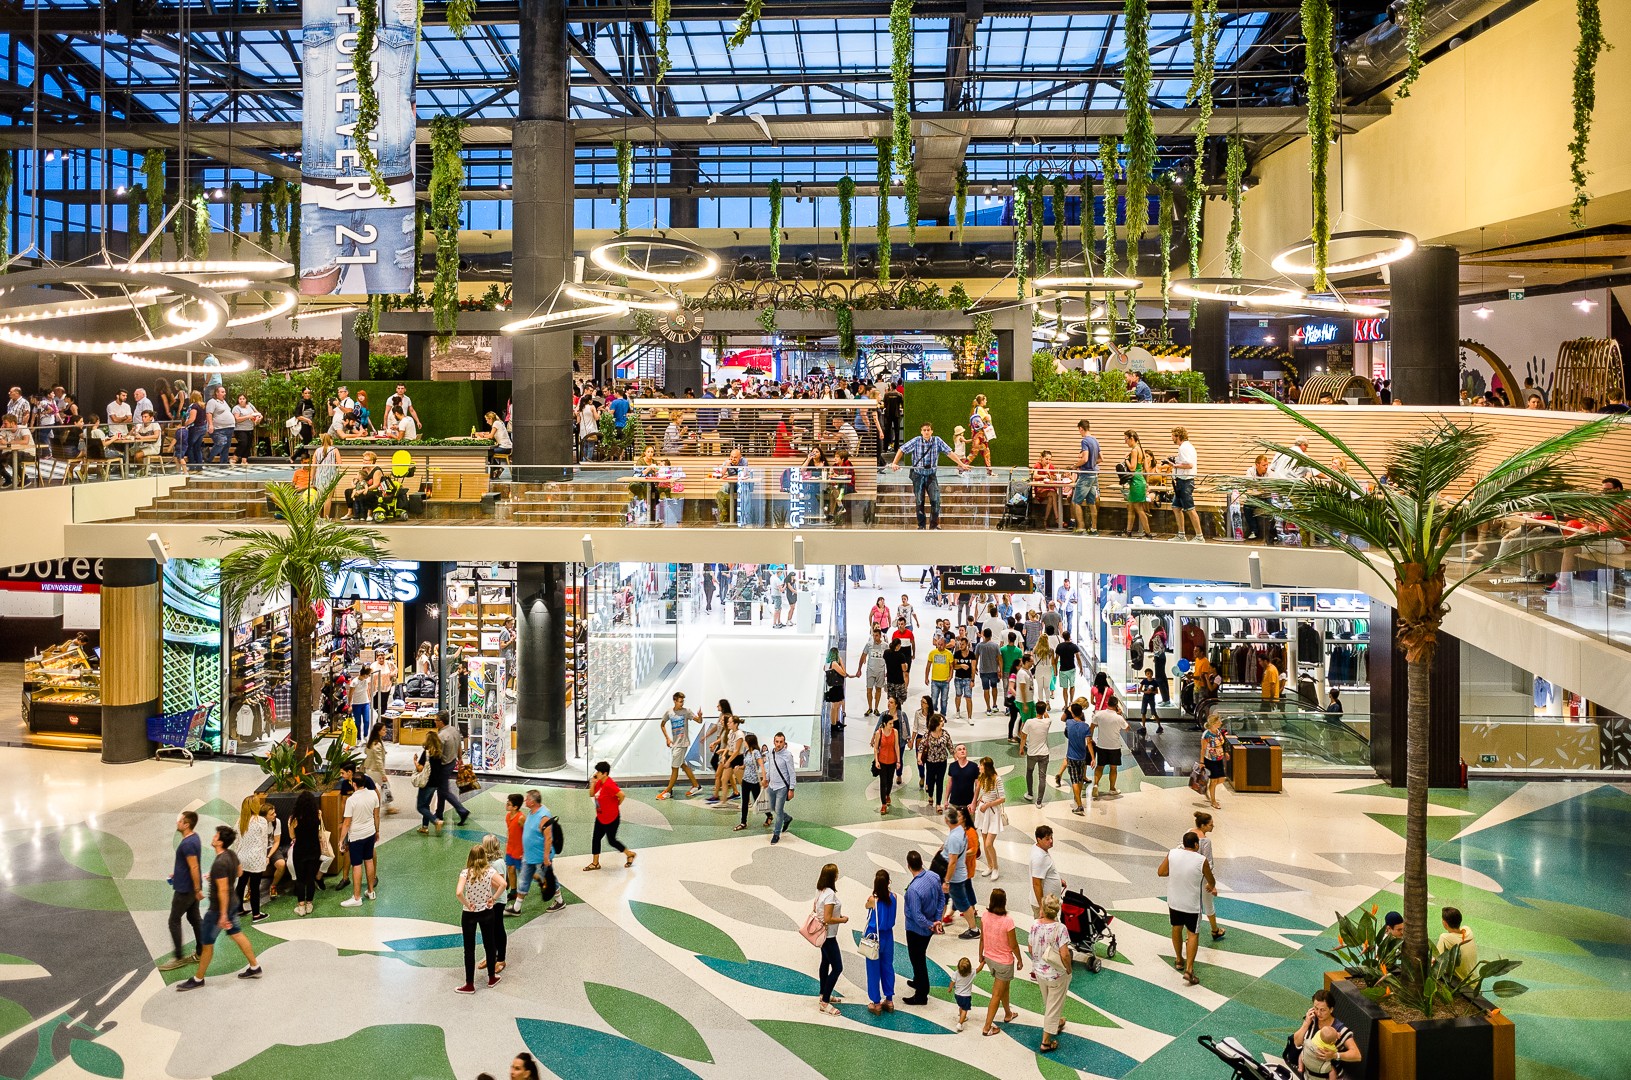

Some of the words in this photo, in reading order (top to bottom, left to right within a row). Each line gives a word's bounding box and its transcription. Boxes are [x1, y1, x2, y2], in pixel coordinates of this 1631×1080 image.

[335, 6, 379, 200] FOREVER
[335, 224, 378, 264] 21
[1354, 318, 1386, 341] KFC
[41, 583, 83, 592] VIENNOISERIE
[320, 560, 419, 602] VANS
[956, 578, 984, 586] Carrefour
